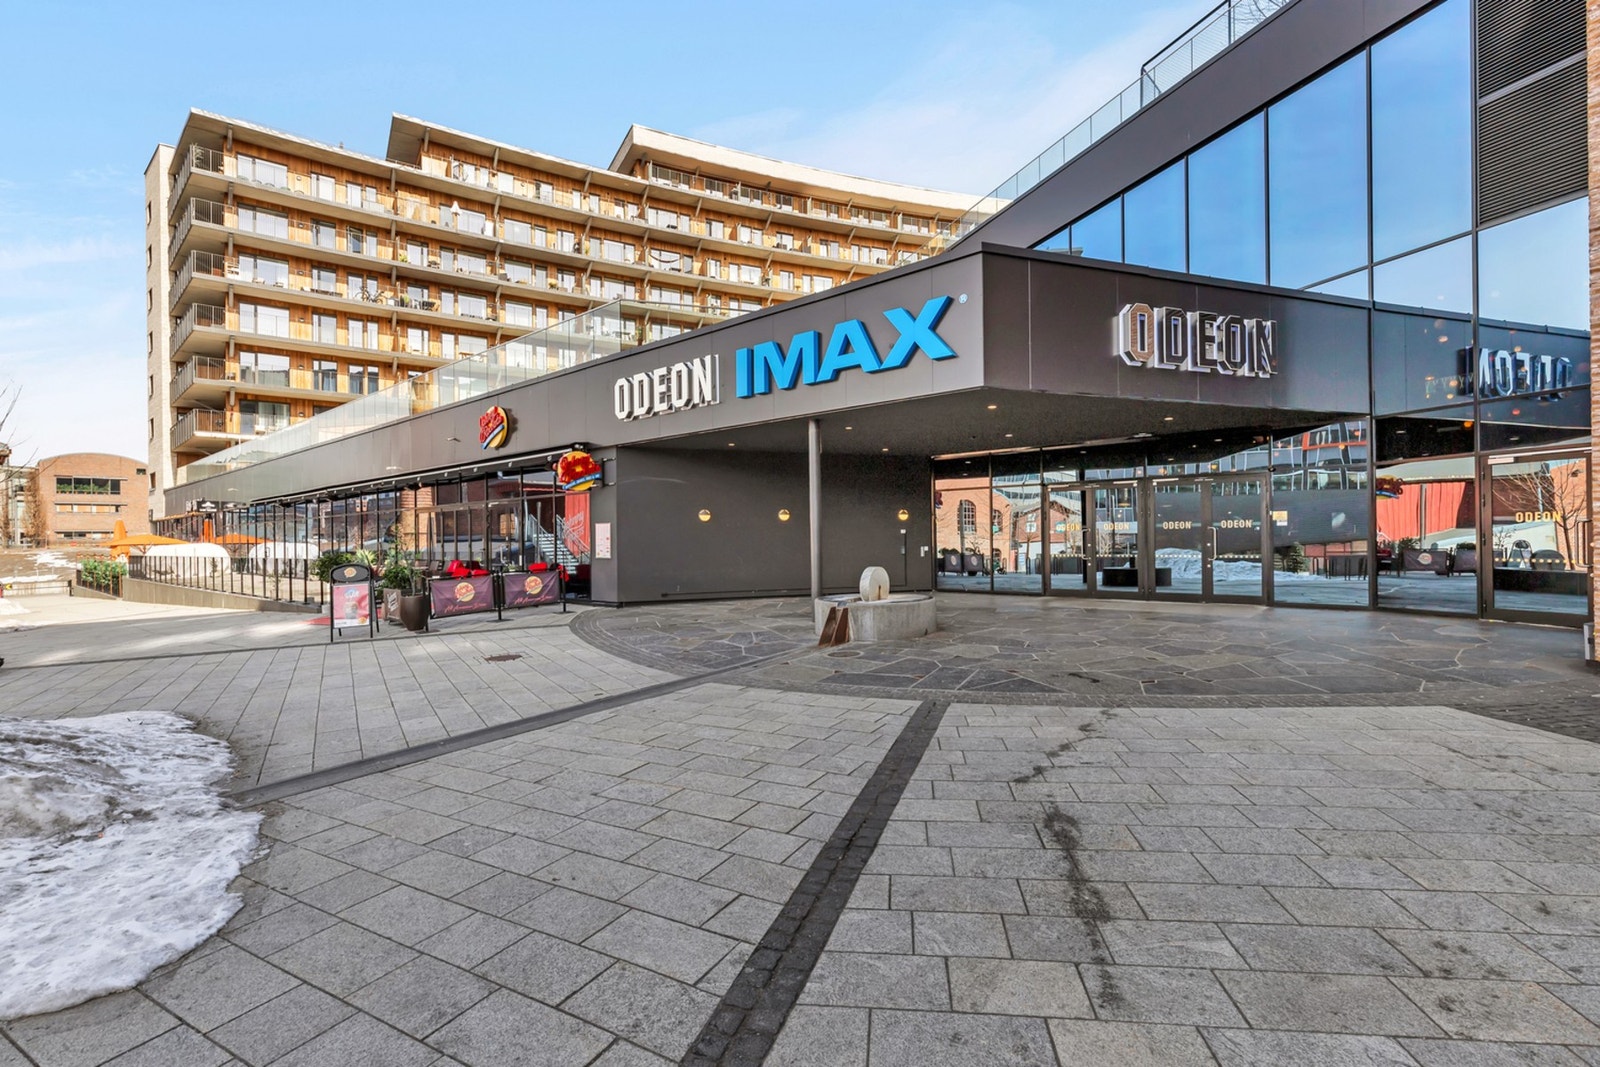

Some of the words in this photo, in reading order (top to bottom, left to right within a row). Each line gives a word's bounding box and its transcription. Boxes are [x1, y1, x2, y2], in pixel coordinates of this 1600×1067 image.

[1118, 302, 1279, 379] ODEON
[614, 354, 720, 421] ODEON
[735, 295, 958, 399] IMAX
[1515, 511, 1561, 523] ODEON
[1103, 522, 1130, 531] ODEON
[1162, 521, 1192, 530] ODEON
[1220, 519, 1253, 529] ODEON
